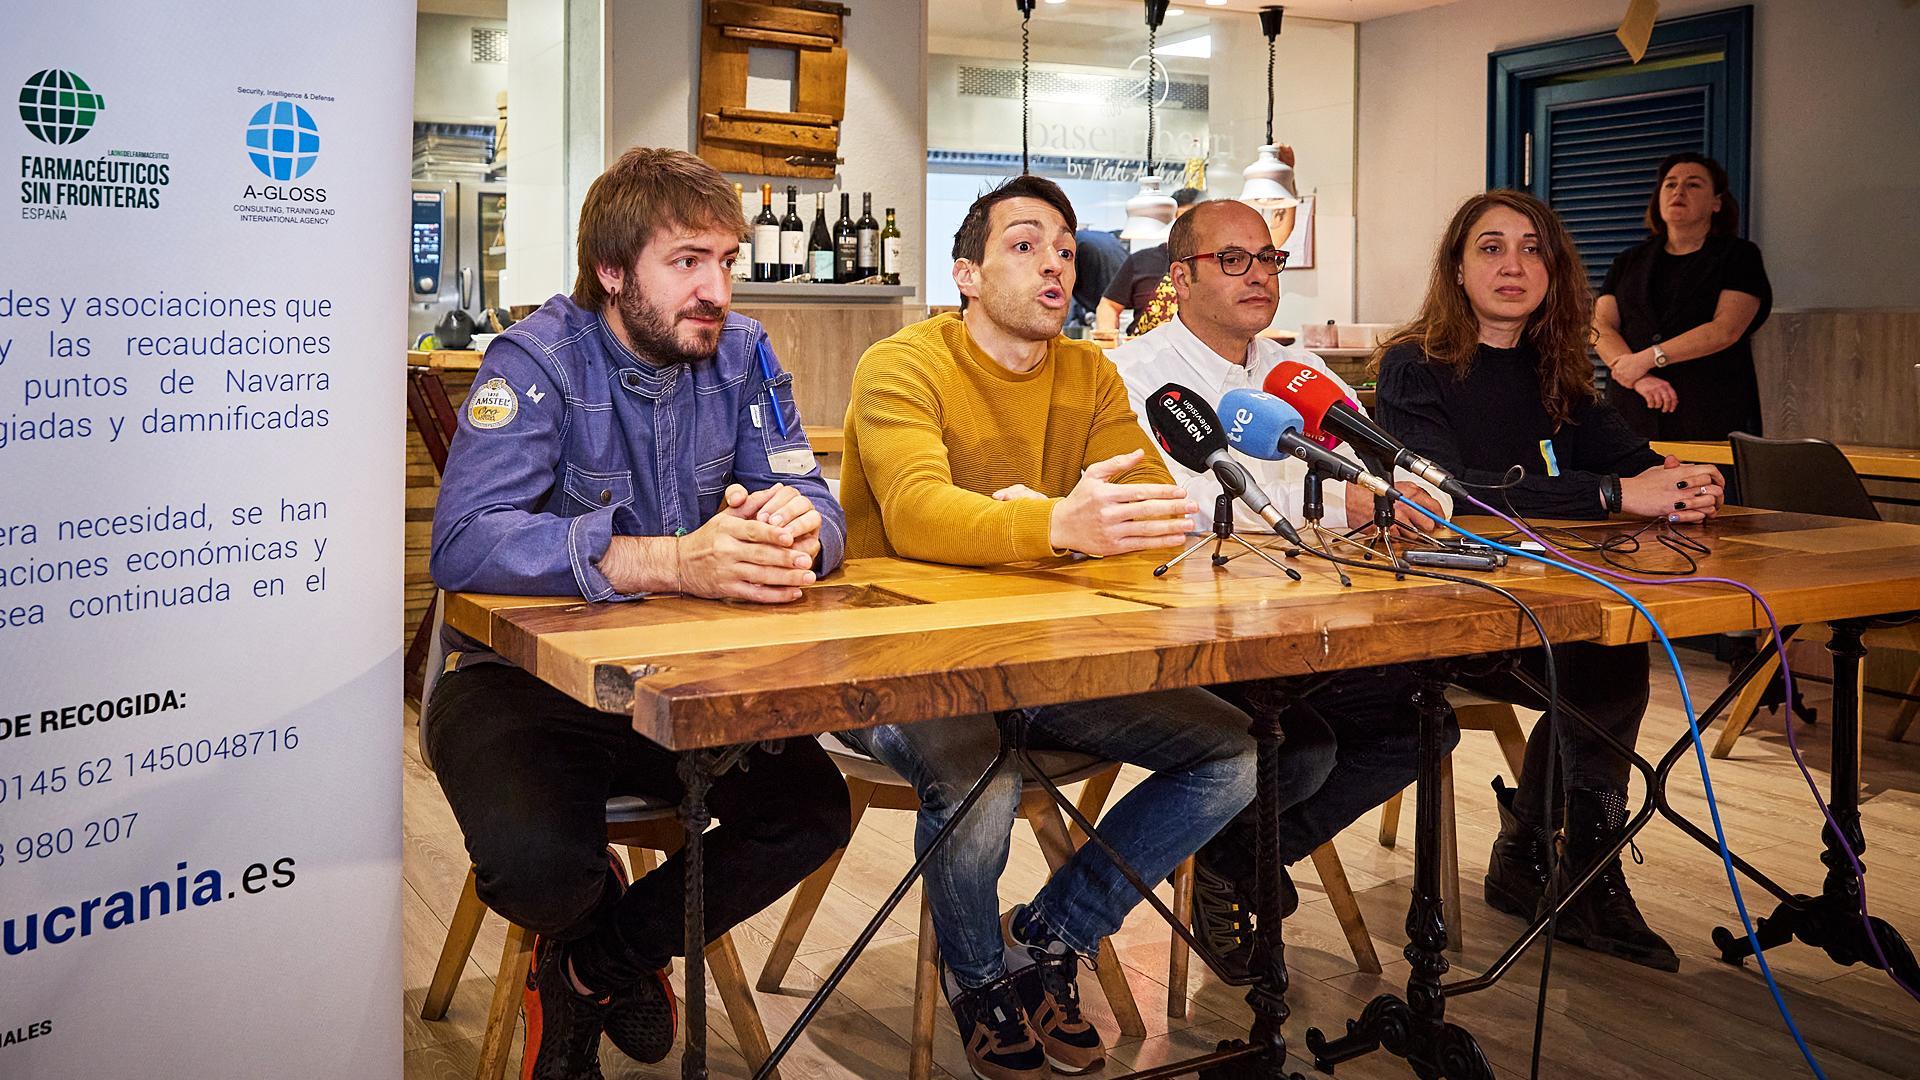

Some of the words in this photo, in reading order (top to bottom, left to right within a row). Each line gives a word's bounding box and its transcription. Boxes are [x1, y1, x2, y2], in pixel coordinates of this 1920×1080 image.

[237, 86, 265, 96] Security,
[267, 89, 302, 98] Intelligence
[310, 93, 335, 101] Defense
[21, 156, 170, 186] FARMACÉUTICOS
[1067, 156, 1087, 179] by
[21, 181, 51, 205] SIN
[56, 183, 161, 209] FRONTERAS
[233, 204, 284, 215] CONSULTING,
[285, 206, 319, 216] TRAINING
[320, 208, 336, 216] AND
[243, 184, 327, 203] A-GLOSS
[21, 205, 67, 221] ESPAÑA
[240, 214, 298, 224] INTERNATIONAL
[299, 216, 330, 225] AGENCY
[0, 289, 50, 317] des
[61, 297, 77, 324] y
[86, 291, 276, 317] asociaciones
[286, 299, 332, 324] que
[50, 331, 91, 358] las
[127, 330, 331, 357] recaudaciones
[25, 373, 128, 406] puntos
[160, 369, 195, 395] de
[226, 369, 330, 393] Navarra
[1286, 369, 1318, 393] rne
[475, 397, 509, 406] AMSTEL
[1182, 400, 1213, 435] televisión
[109, 415, 126, 443] y
[142, 403, 329, 434] damnificadas
[1163, 397, 1205, 443] Navarra
[1227, 408, 1253, 443] tve
[59, 503, 213, 541] necesidad,
[231, 507, 263, 526] se
[280, 498, 327, 523] han
[126, 541, 298, 573] económicas
[313, 537, 328, 562] y
[69, 577, 230, 619] continuada
[252, 578, 284, 598] en
[305, 567, 326, 592] el
[0, 713, 32, 741] DE
[39, 689, 187, 734] RECOGIDA:
[77, 758, 113, 787] 62
[123, 726, 299, 777] 1450048716
[15, 827, 74, 863] 980
[84, 812, 139, 849] 207
[2, 856, 296, 956] ucrania.es
